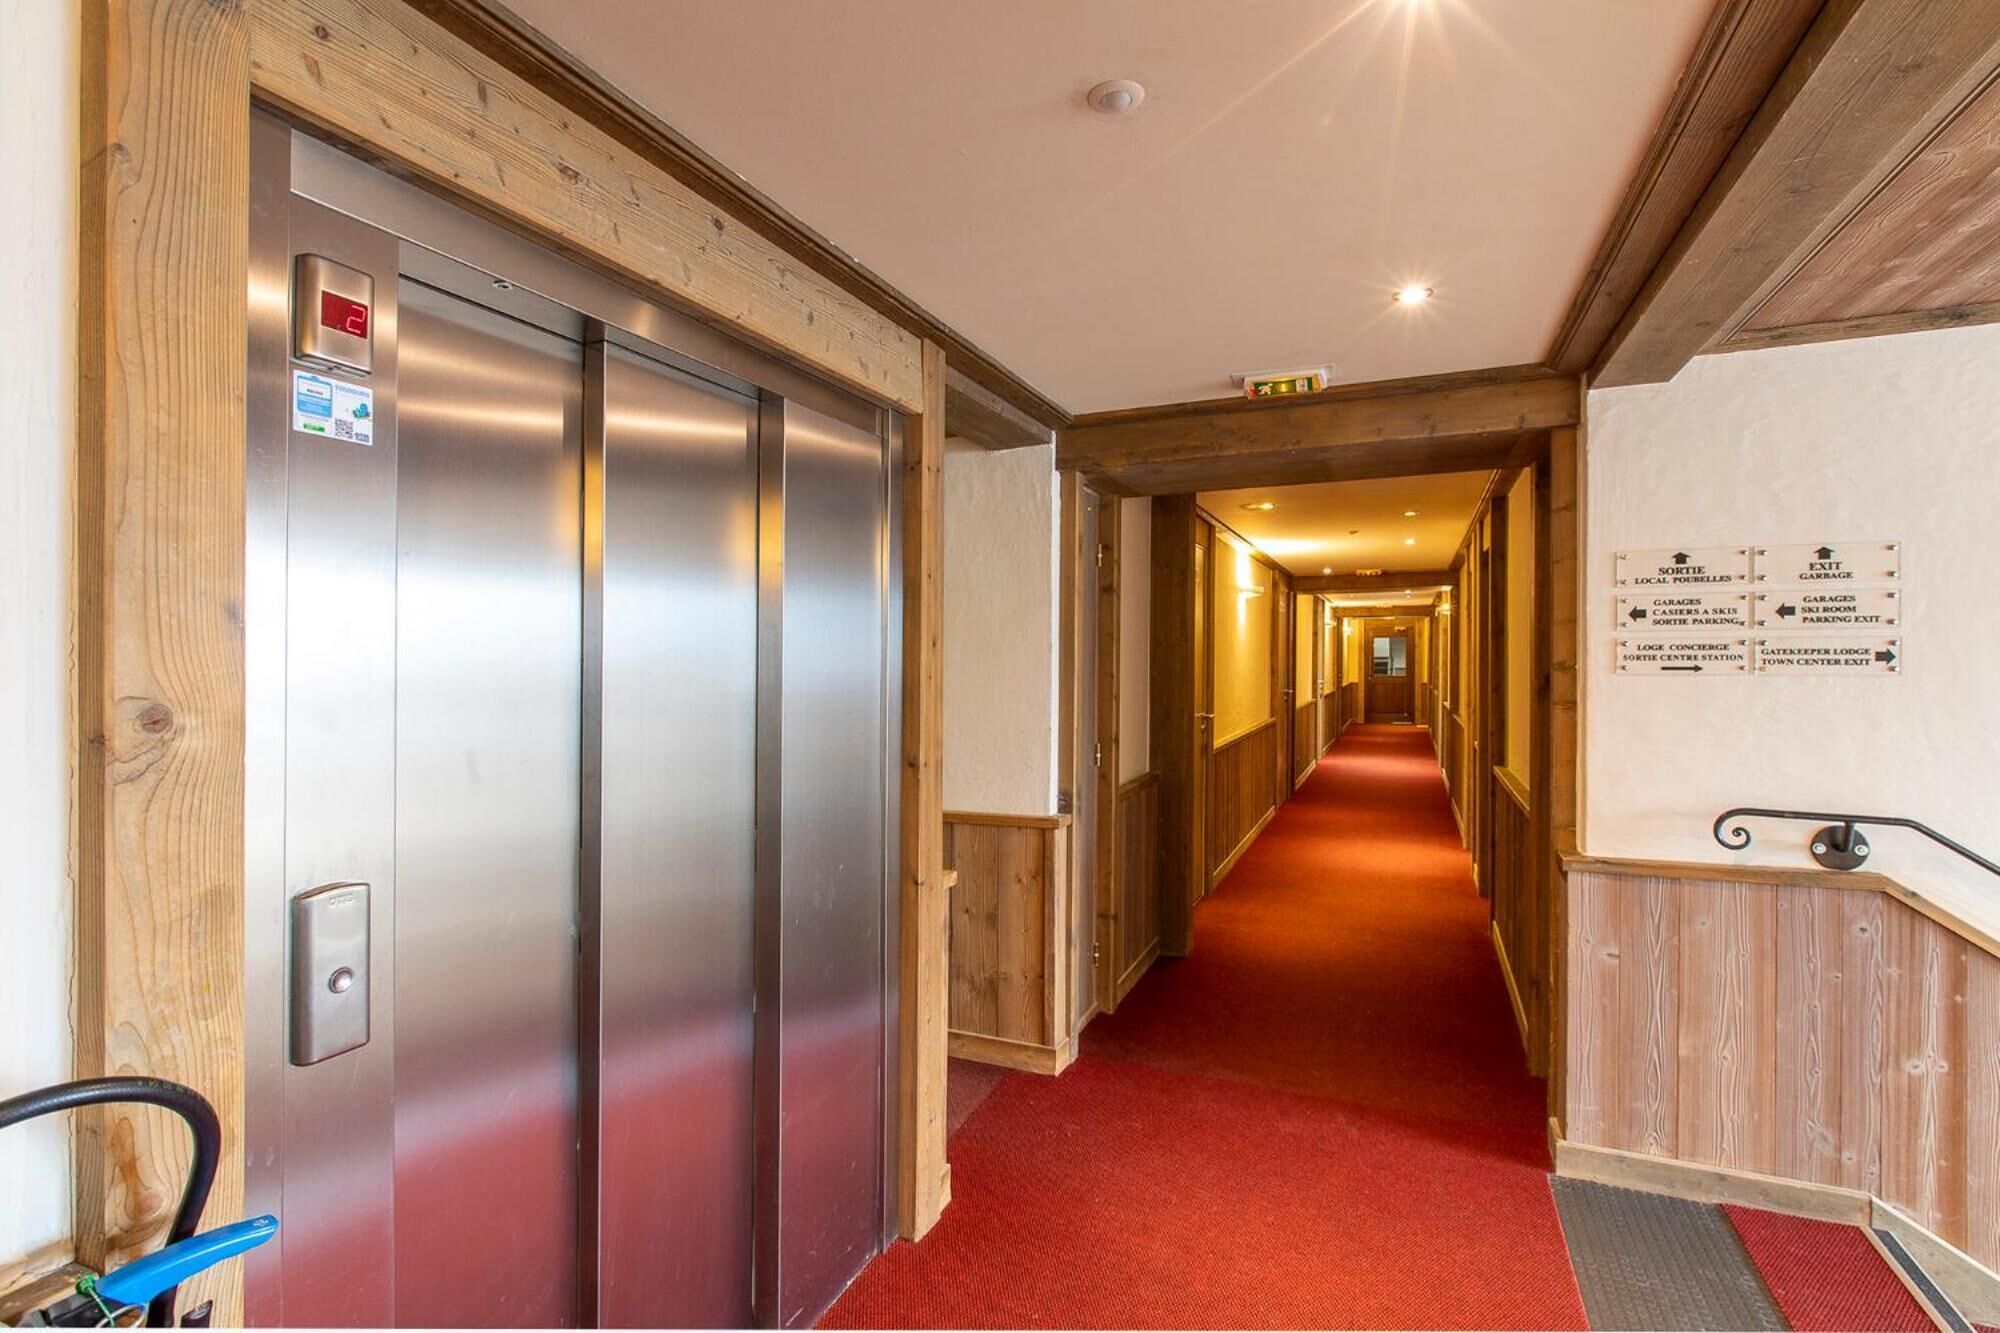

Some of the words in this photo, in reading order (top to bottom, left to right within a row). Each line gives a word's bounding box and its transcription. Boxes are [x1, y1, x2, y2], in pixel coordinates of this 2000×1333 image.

[346, 304, 366, 334] 2
[1658, 566, 1706, 576] SORTIE
[1809, 562, 1843, 571] EXIT
[1635, 577, 1669, 585] LOCAL
[1672, 575, 1733, 585] POUBELLES
[1799, 571, 1854, 580] GARBAGE
[1653, 598, 1702, 606] GARAGES
[1802, 595, 1856, 603] GARAGES
[1652, 608, 1700, 616] CASIERS
[1801, 606, 1820, 614] SKI
[1822, 605, 1857, 614] ROOM
[1652, 618, 1689, 626] SORTIE
[1692, 617, 1739, 625] PARKING
[1802, 616, 1852, 624] PARKING
[1854, 615, 1881, 623] EXIT
[1669, 643, 1730, 651] CONCIERGE
[1761, 648, 1831, 656] GATEKEEPER
[1834, 647, 1872, 655] LODGE
[1761, 658, 1794, 666] TOWN
[1796, 658, 1841, 666] CENTER
[1844, 658, 1872, 666] EXIT
